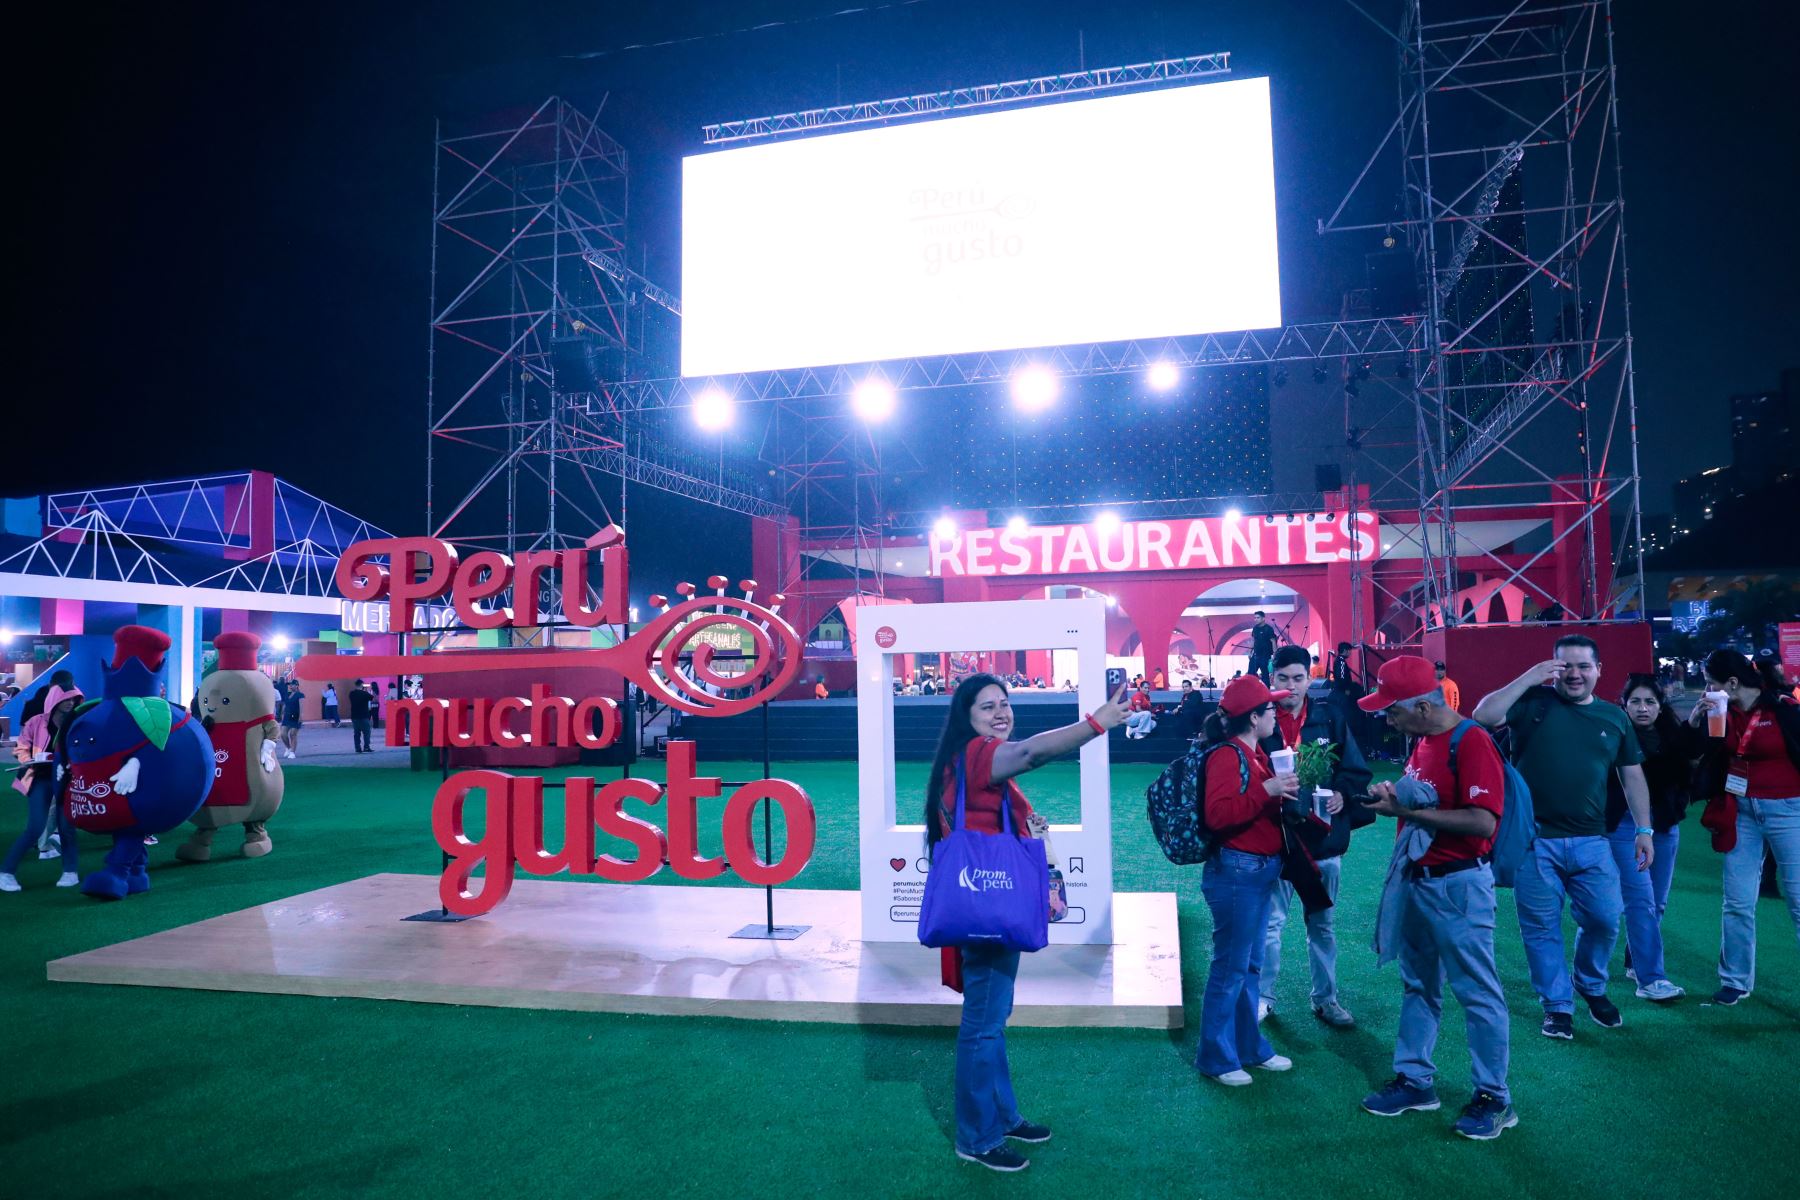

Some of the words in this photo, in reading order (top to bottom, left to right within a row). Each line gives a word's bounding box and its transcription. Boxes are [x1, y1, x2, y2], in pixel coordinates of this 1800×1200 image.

[921, 227, 1024, 276] gusto
[930, 513, 1375, 577] RESTAURANTES
[336, 524, 629, 632] Perú
[341, 600, 459, 636] MERADO
[385, 684, 622, 749] mucho
[432, 740, 815, 916] gusto
[971, 868, 1006, 882] prom
[983, 877, 1013, 891] perú
